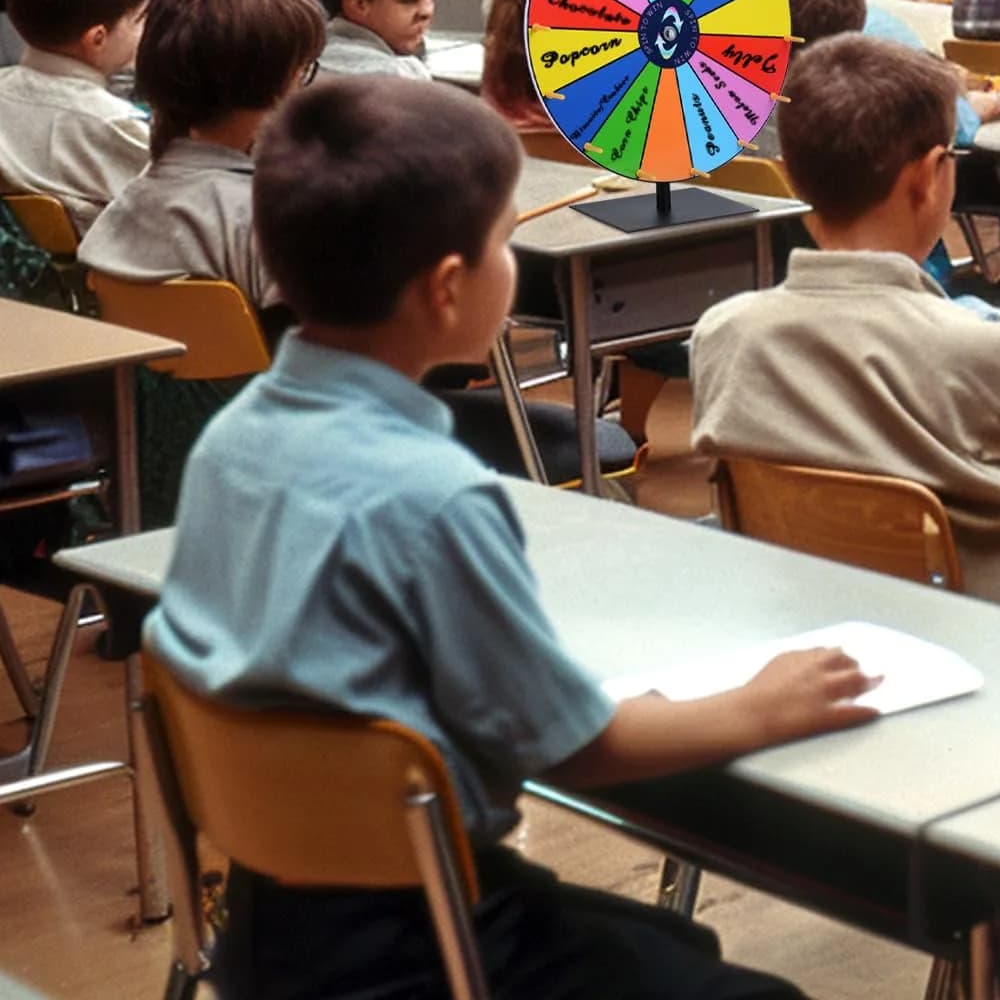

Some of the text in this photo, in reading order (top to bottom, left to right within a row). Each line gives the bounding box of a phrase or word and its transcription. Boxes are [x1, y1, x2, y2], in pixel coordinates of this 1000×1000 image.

[540, 37, 623, 69] Popcorn
[721, 43, 778, 74] Jelly
[692, 92, 720, 157] Peanuts
